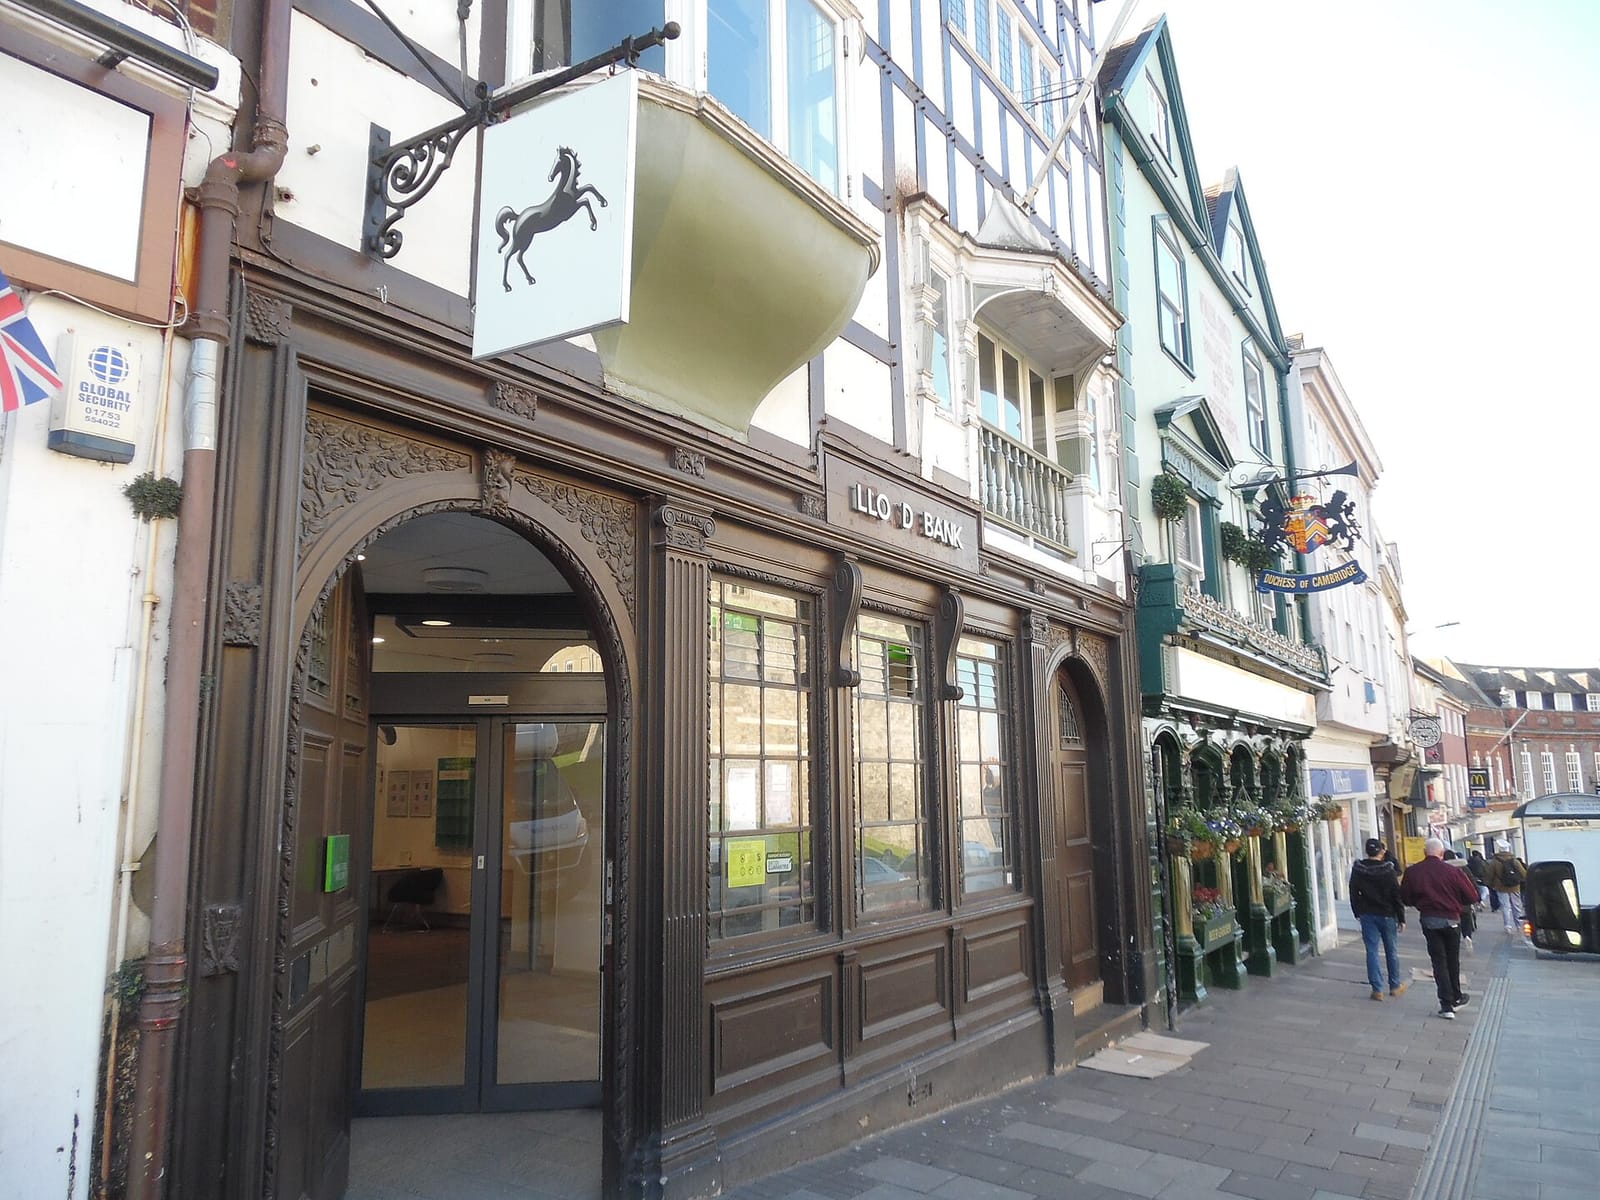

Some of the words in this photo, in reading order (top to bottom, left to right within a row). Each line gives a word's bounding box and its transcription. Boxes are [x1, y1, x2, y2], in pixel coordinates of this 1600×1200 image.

[78, 392, 131, 413] SECURITY
[79, 381, 132, 403] GLOBAL
[84, 406, 121, 421] 01753
[84, 416, 121, 428] 554022
[922, 511, 964, 550] BANK
[1263, 573, 1296, 589] DUCHESS
[1300, 579, 1310, 589] OF
[1312, 563, 1358, 588] CAMBRIDGE
